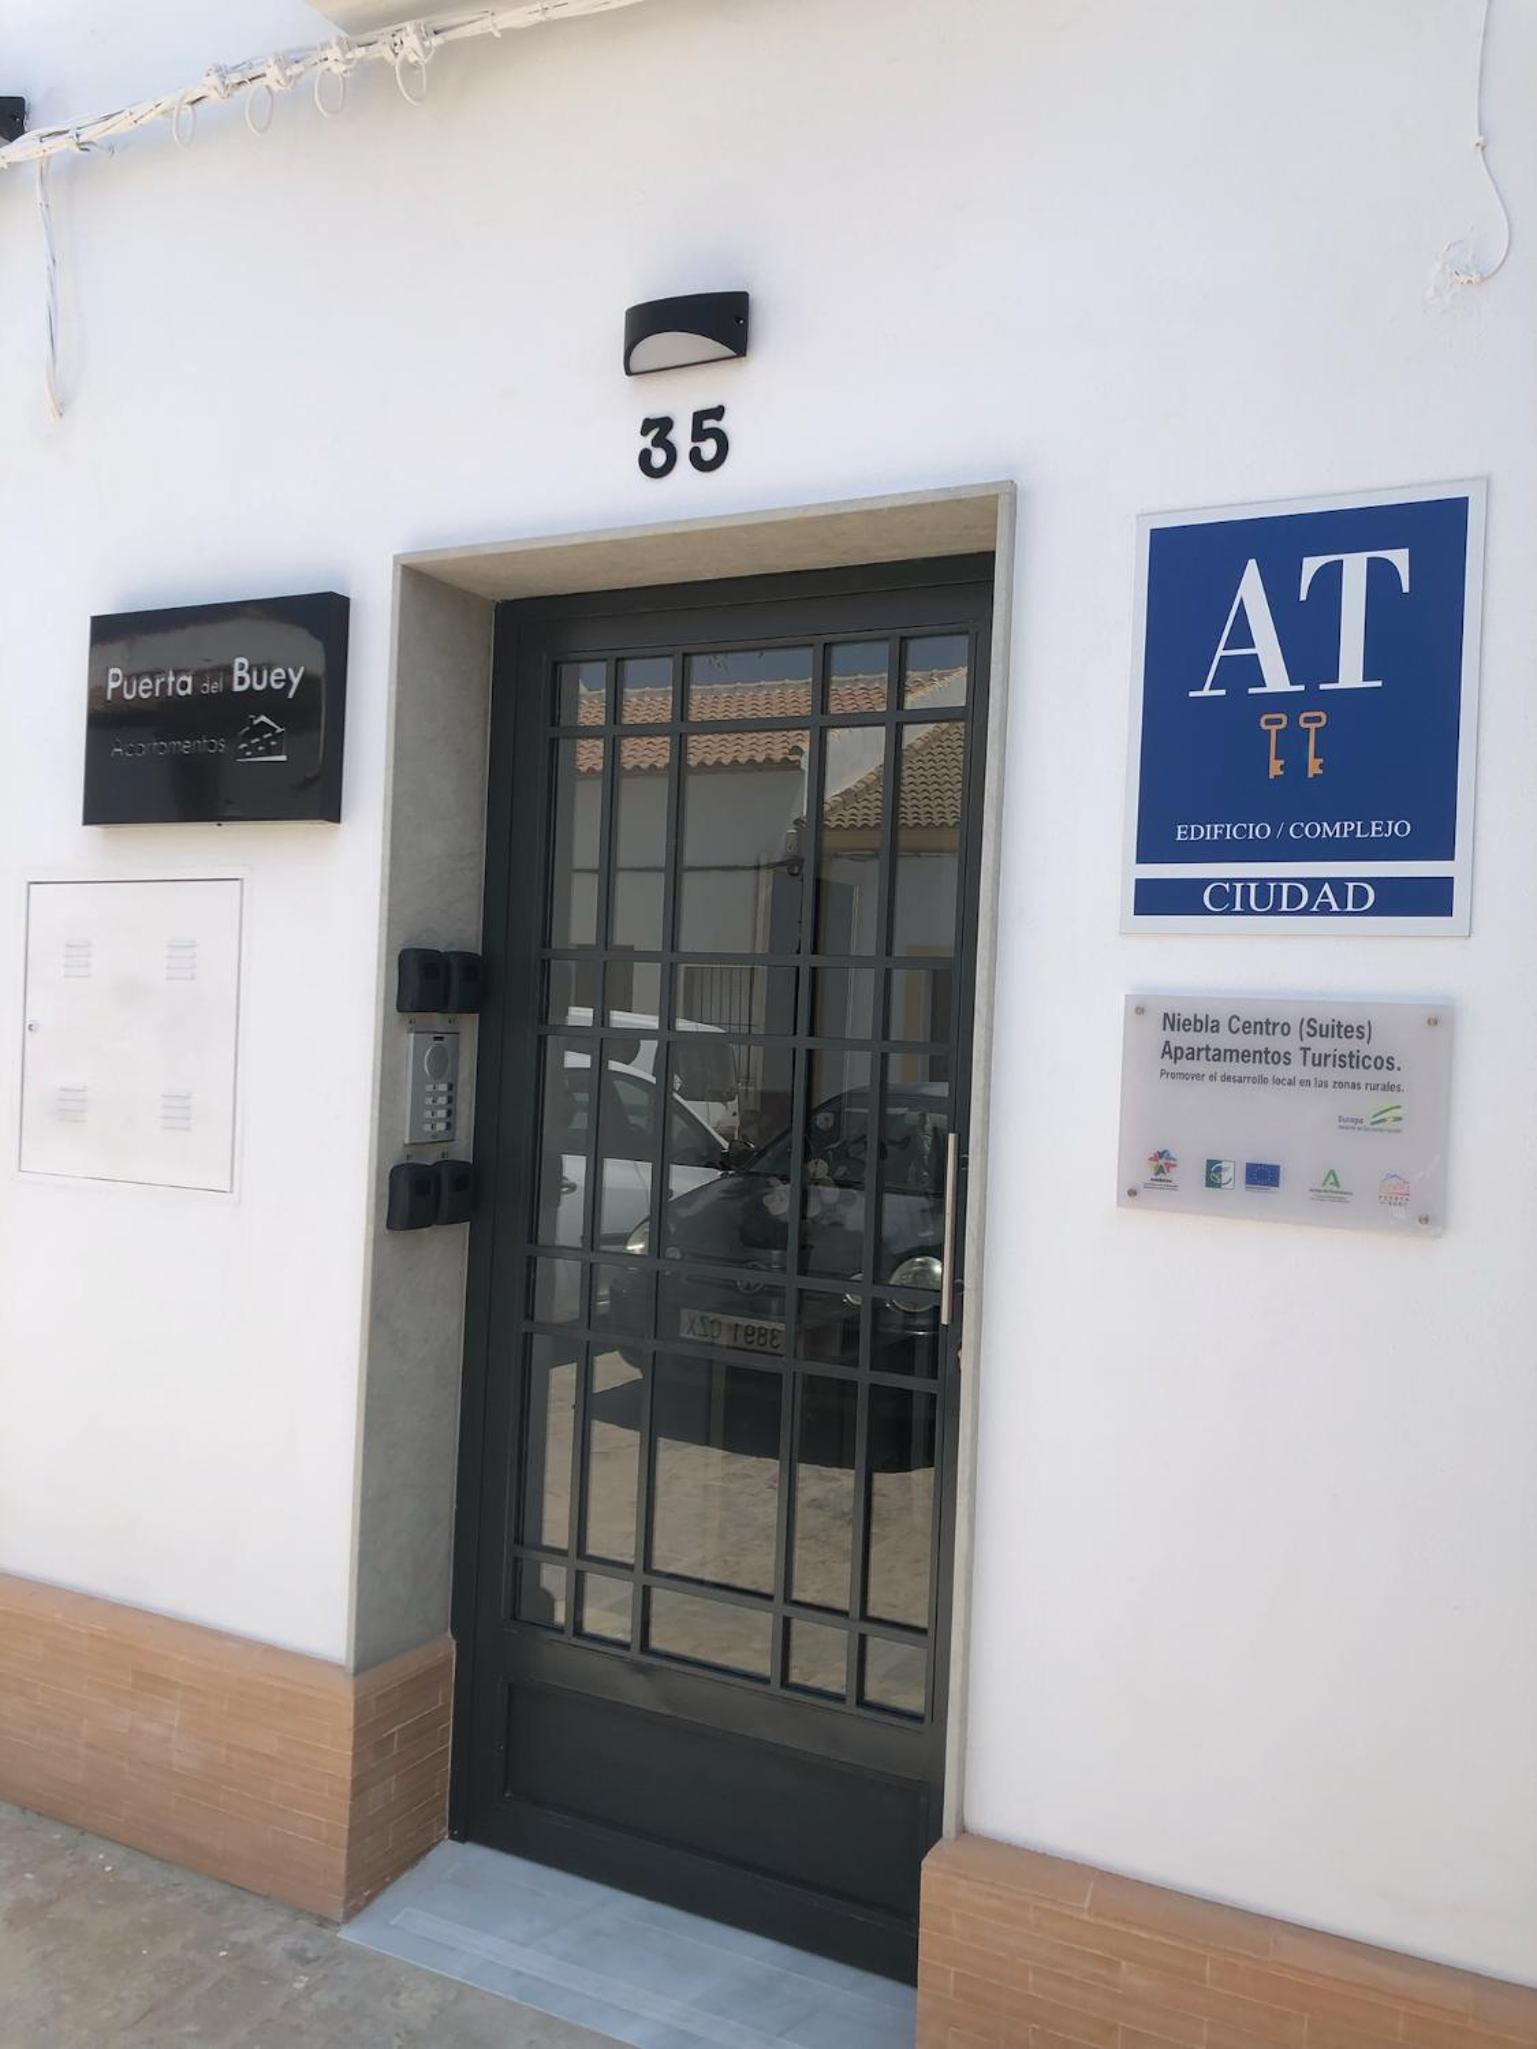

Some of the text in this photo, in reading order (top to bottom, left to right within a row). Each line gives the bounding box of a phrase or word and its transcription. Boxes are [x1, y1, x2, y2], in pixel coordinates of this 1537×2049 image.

[638, 404, 729, 479] 35
[1189, 548, 1410, 697] AT
[107, 657, 304, 700] Puerta del Buey
[1175, 822, 1271, 841] EDIFICIO
[1289, 819, 1411, 839] COMPLEJO
[1202, 881, 1376, 912] CIUDAD
[1162, 1012, 1372, 1045] Niebla Centro (Suites)
[1160, 1040, 1401, 1071] Apartamentos Turísticos.
[1160, 1068, 1404, 1093] Promover el desarrollo local en las zonas rurales.
